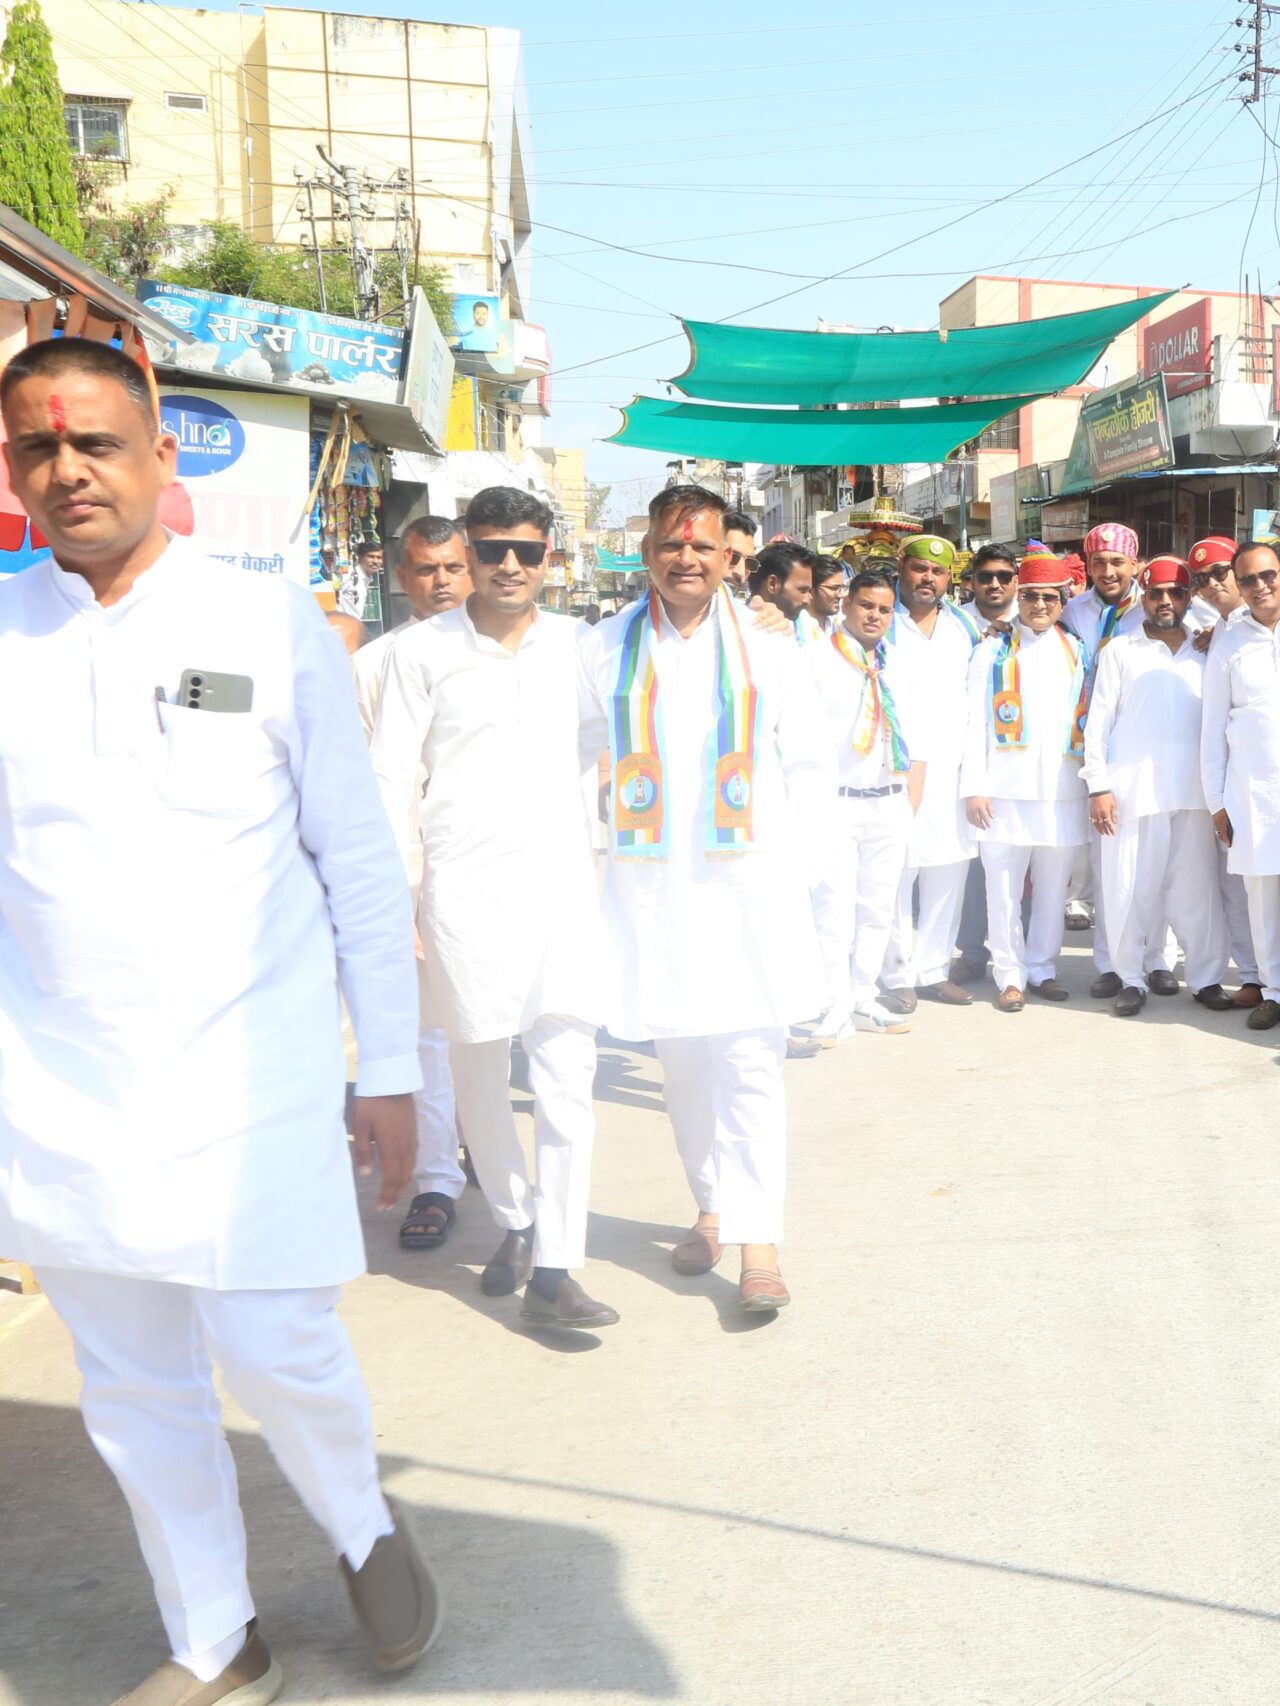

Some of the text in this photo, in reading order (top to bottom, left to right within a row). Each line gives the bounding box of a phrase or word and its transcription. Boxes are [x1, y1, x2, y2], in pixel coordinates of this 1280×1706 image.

[207, 312, 403, 373] सरस पार्लर
[1158, 325, 1199, 369] DOLLAR
[240, 551, 285, 574] बेकरी
